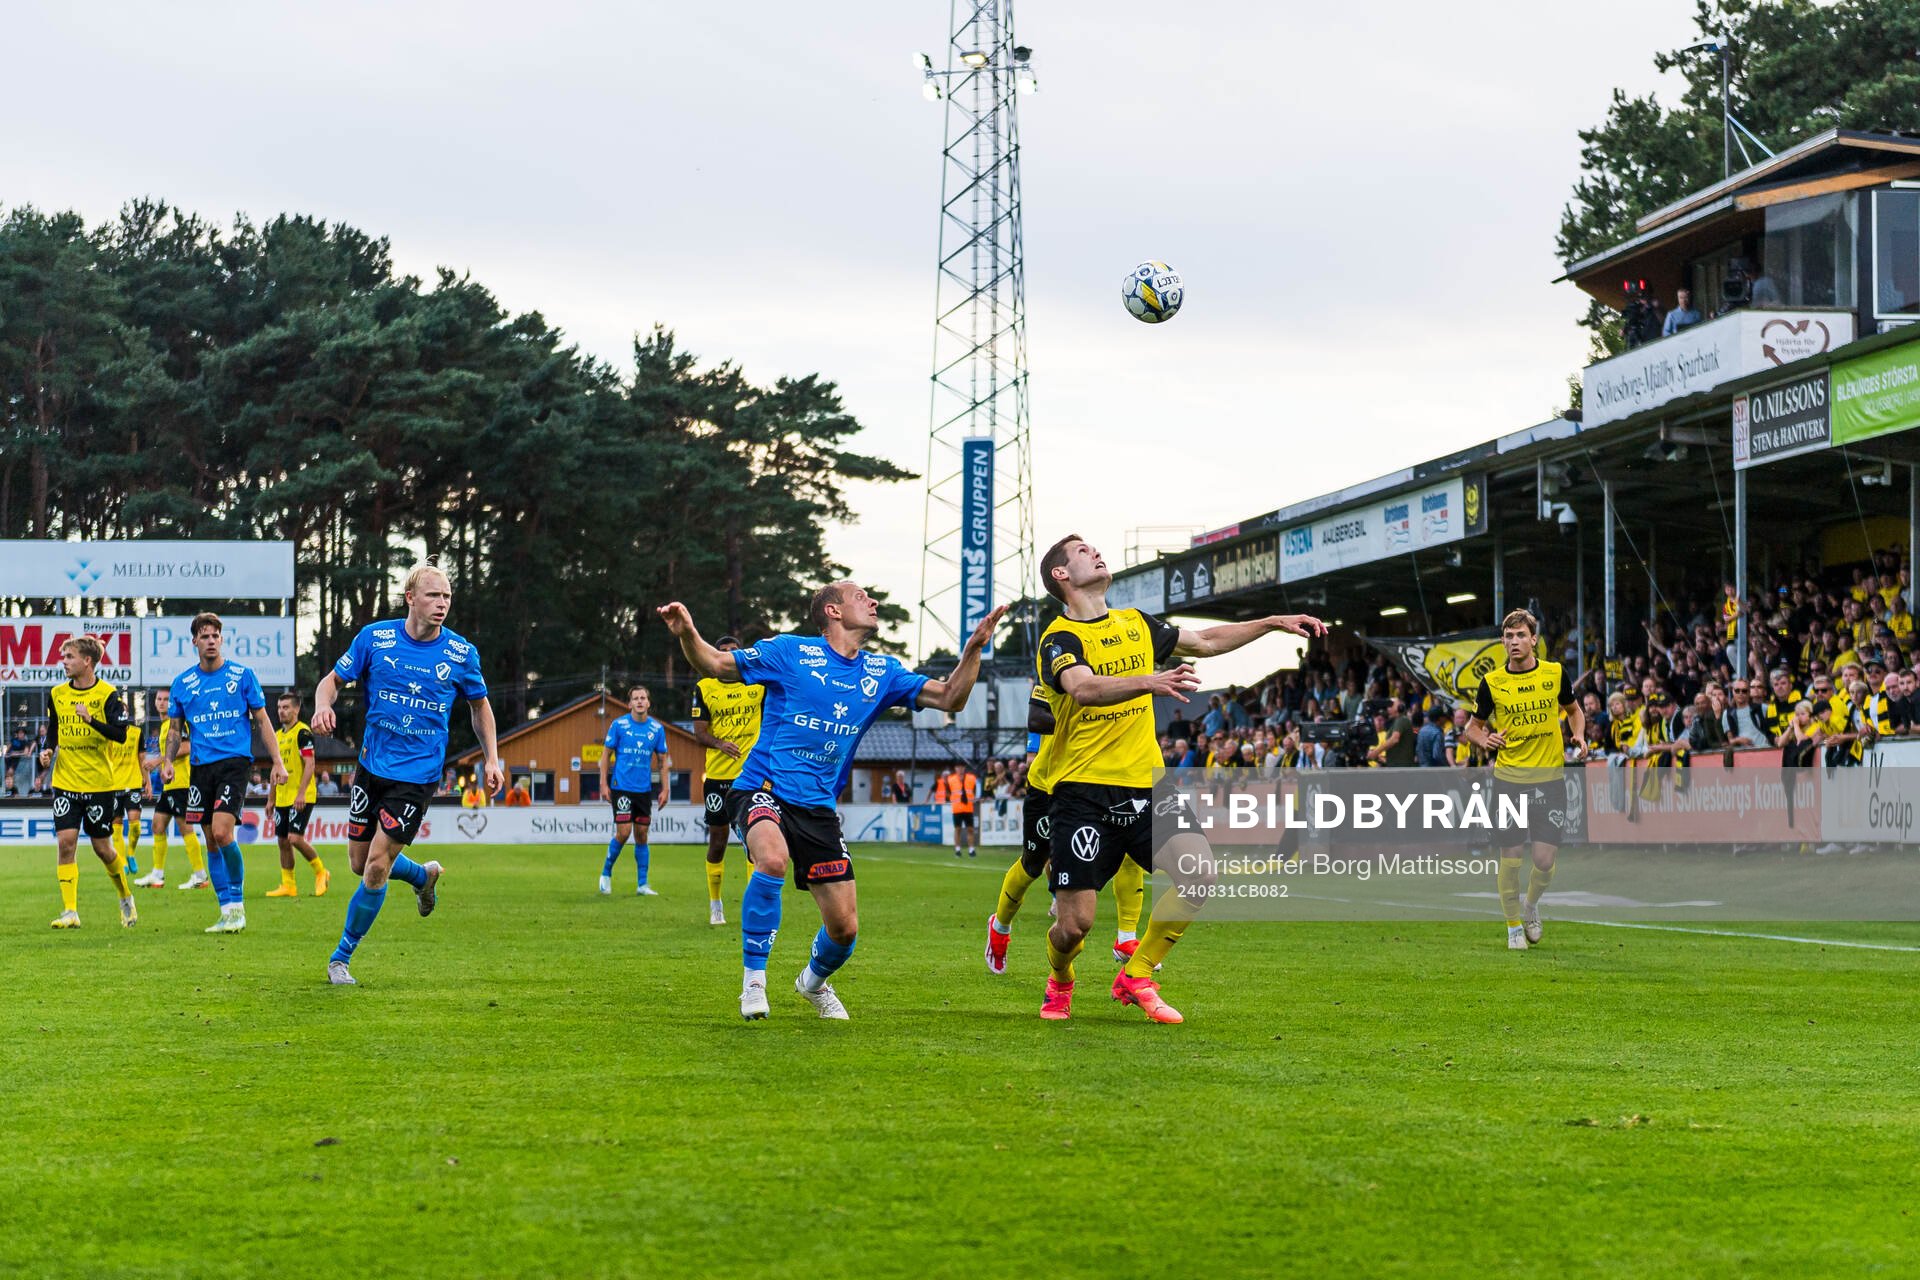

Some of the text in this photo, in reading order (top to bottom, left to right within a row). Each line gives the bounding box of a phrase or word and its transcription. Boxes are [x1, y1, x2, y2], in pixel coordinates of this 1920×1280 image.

[1837, 374, 1880, 402] BLEKINGES
[1882, 363, 1919, 390] STÖRSTA
[1752, 397, 1765, 424] O.
[1766, 378, 1824, 420] NILSSONS
[1752, 417, 1825, 453] STEN & HANTVERK
[972, 449, 989, 546] GRUPPEN
[112, 561, 226, 578] MELLBY GÅRD
[83, 621, 132, 633] Bromölla
[379, 690, 446, 712] GETINGE
[1504, 699, 1554, 715] MELLBY
[1512, 713, 1547, 727] GÅRD
[403, 803, 416, 818] 17
[1869, 791, 1913, 840] Group
[1058, 872, 1070, 886] 18
